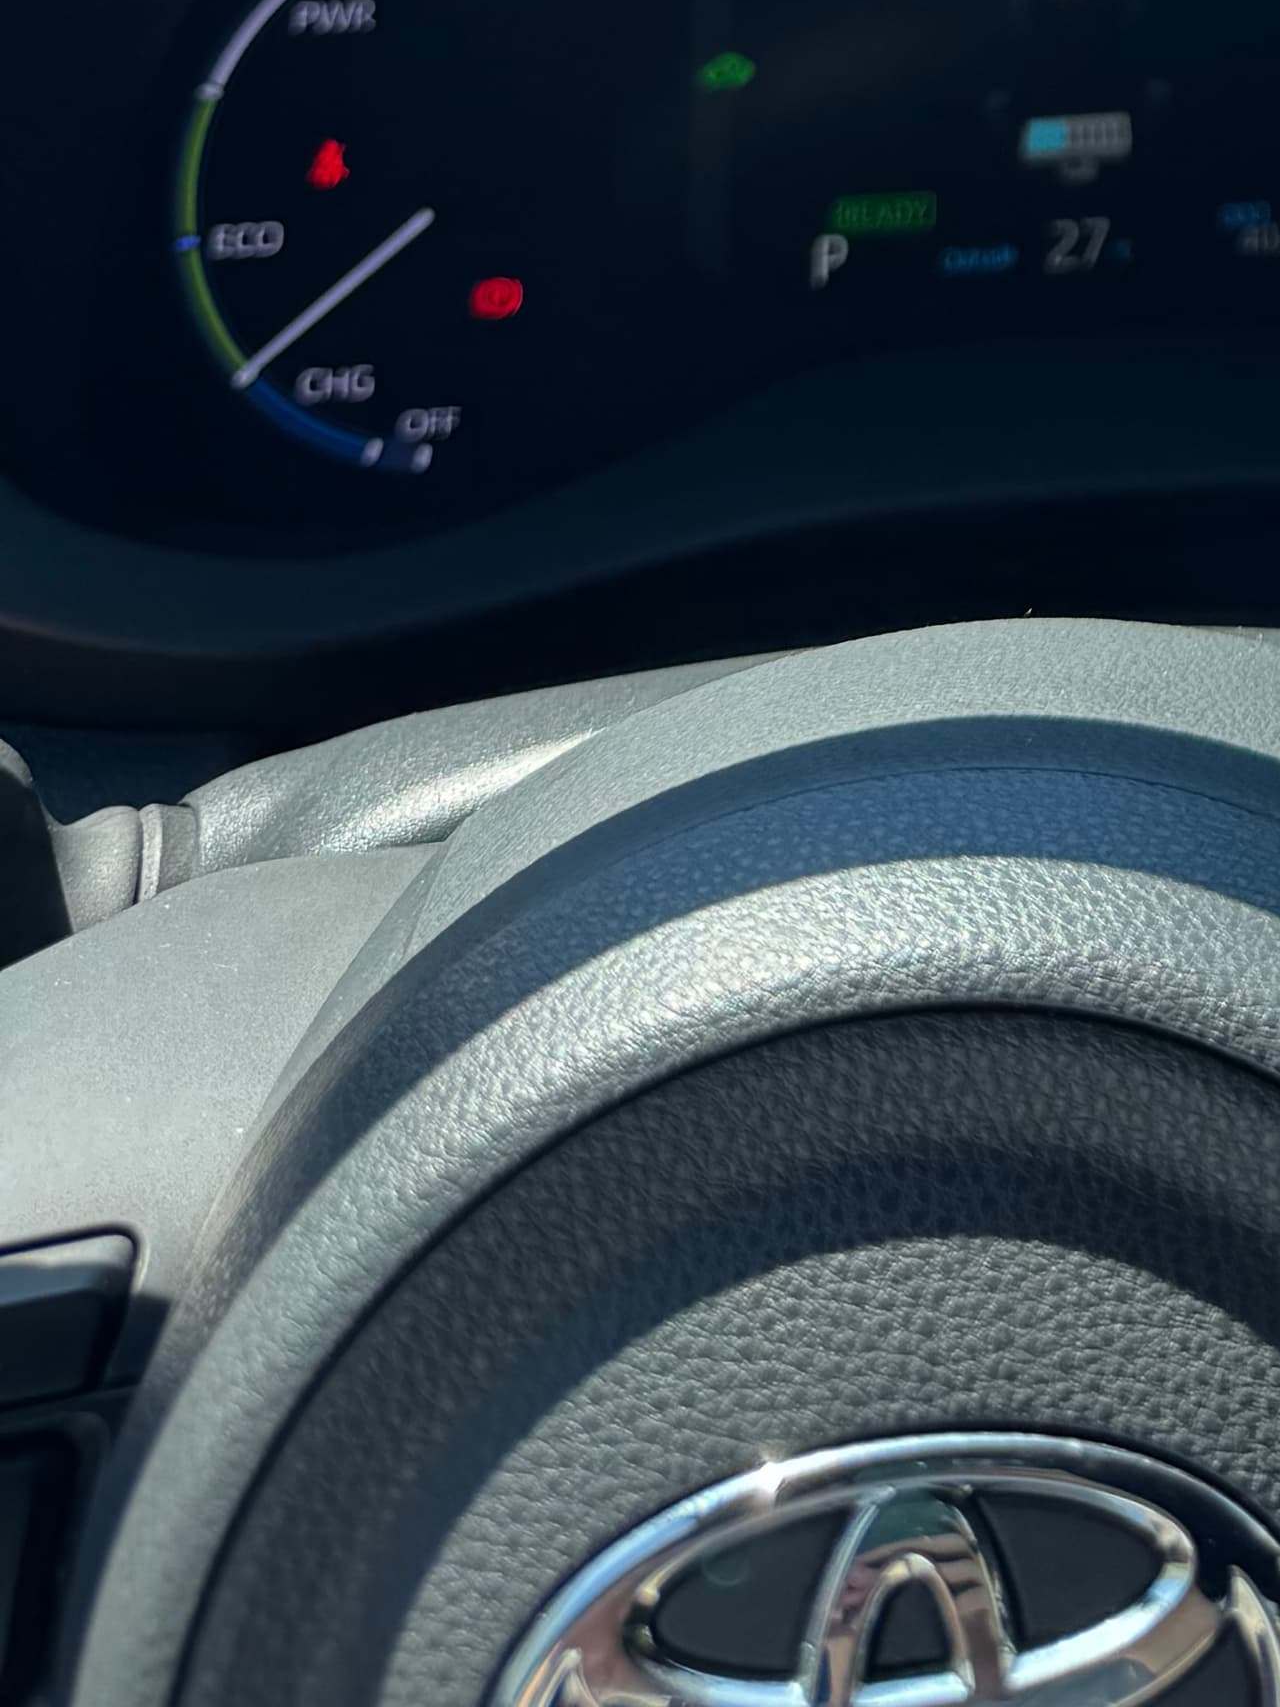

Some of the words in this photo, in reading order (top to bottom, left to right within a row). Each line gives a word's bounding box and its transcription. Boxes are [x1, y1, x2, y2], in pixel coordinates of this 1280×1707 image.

[837, 198, 929, 228] READY
[209, 219, 285, 260] ECO
[1045, 217, 1111, 273] 27
[808, 233, 849, 291] P
[294, 363, 376, 407] CHG
[394, 406, 462, 446] OFF
